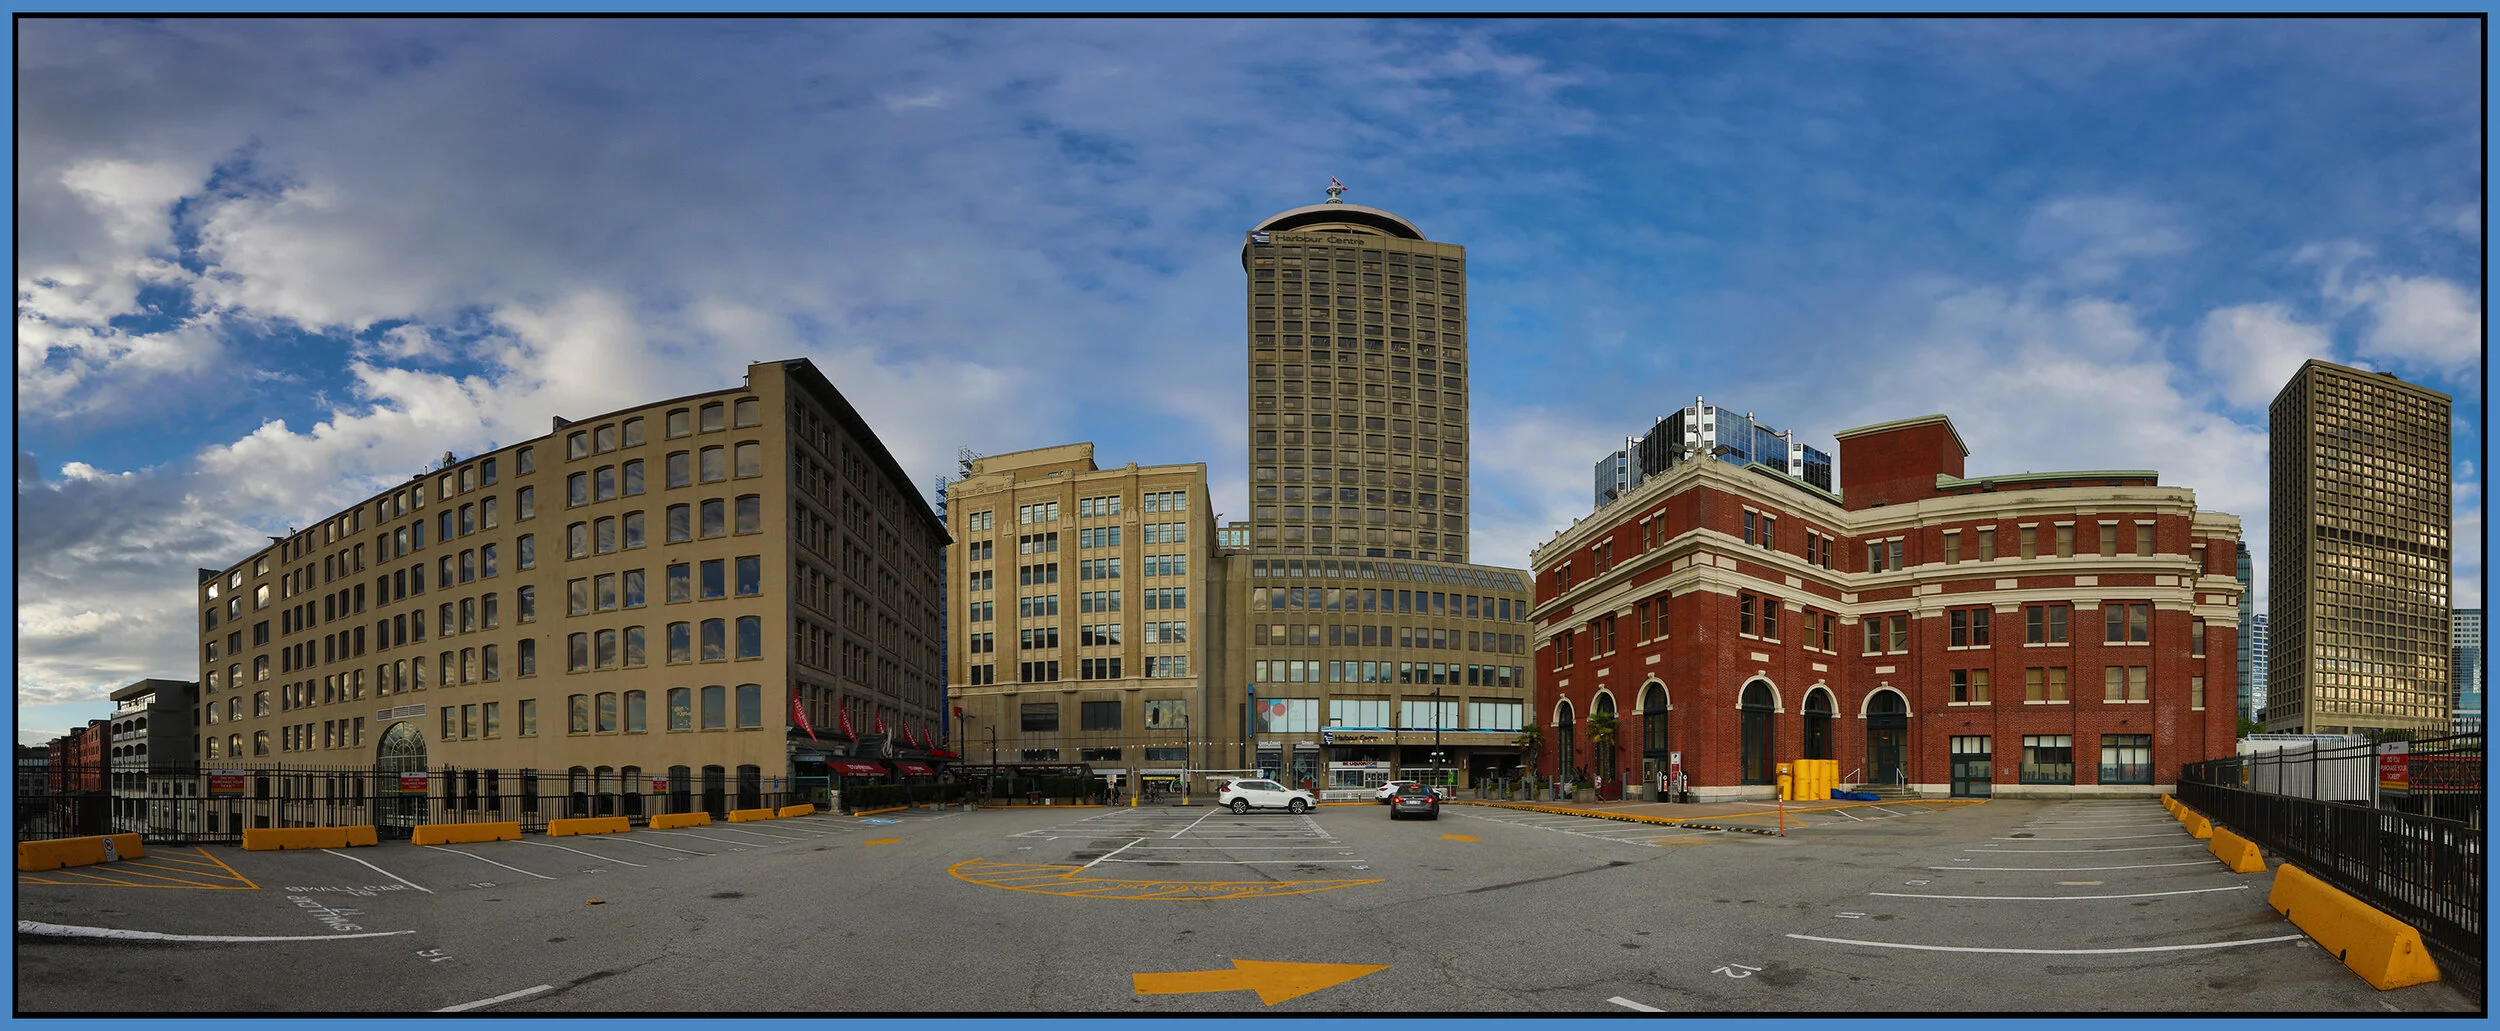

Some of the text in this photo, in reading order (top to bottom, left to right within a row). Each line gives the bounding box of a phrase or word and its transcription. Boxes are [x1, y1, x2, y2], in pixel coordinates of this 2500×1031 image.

[1275, 234, 1365, 245] Harbour Centre
[363, 884, 410, 892] CAR
[1160, 884, 1264, 892] PARKING
[1711, 963, 1762, 979] 12
